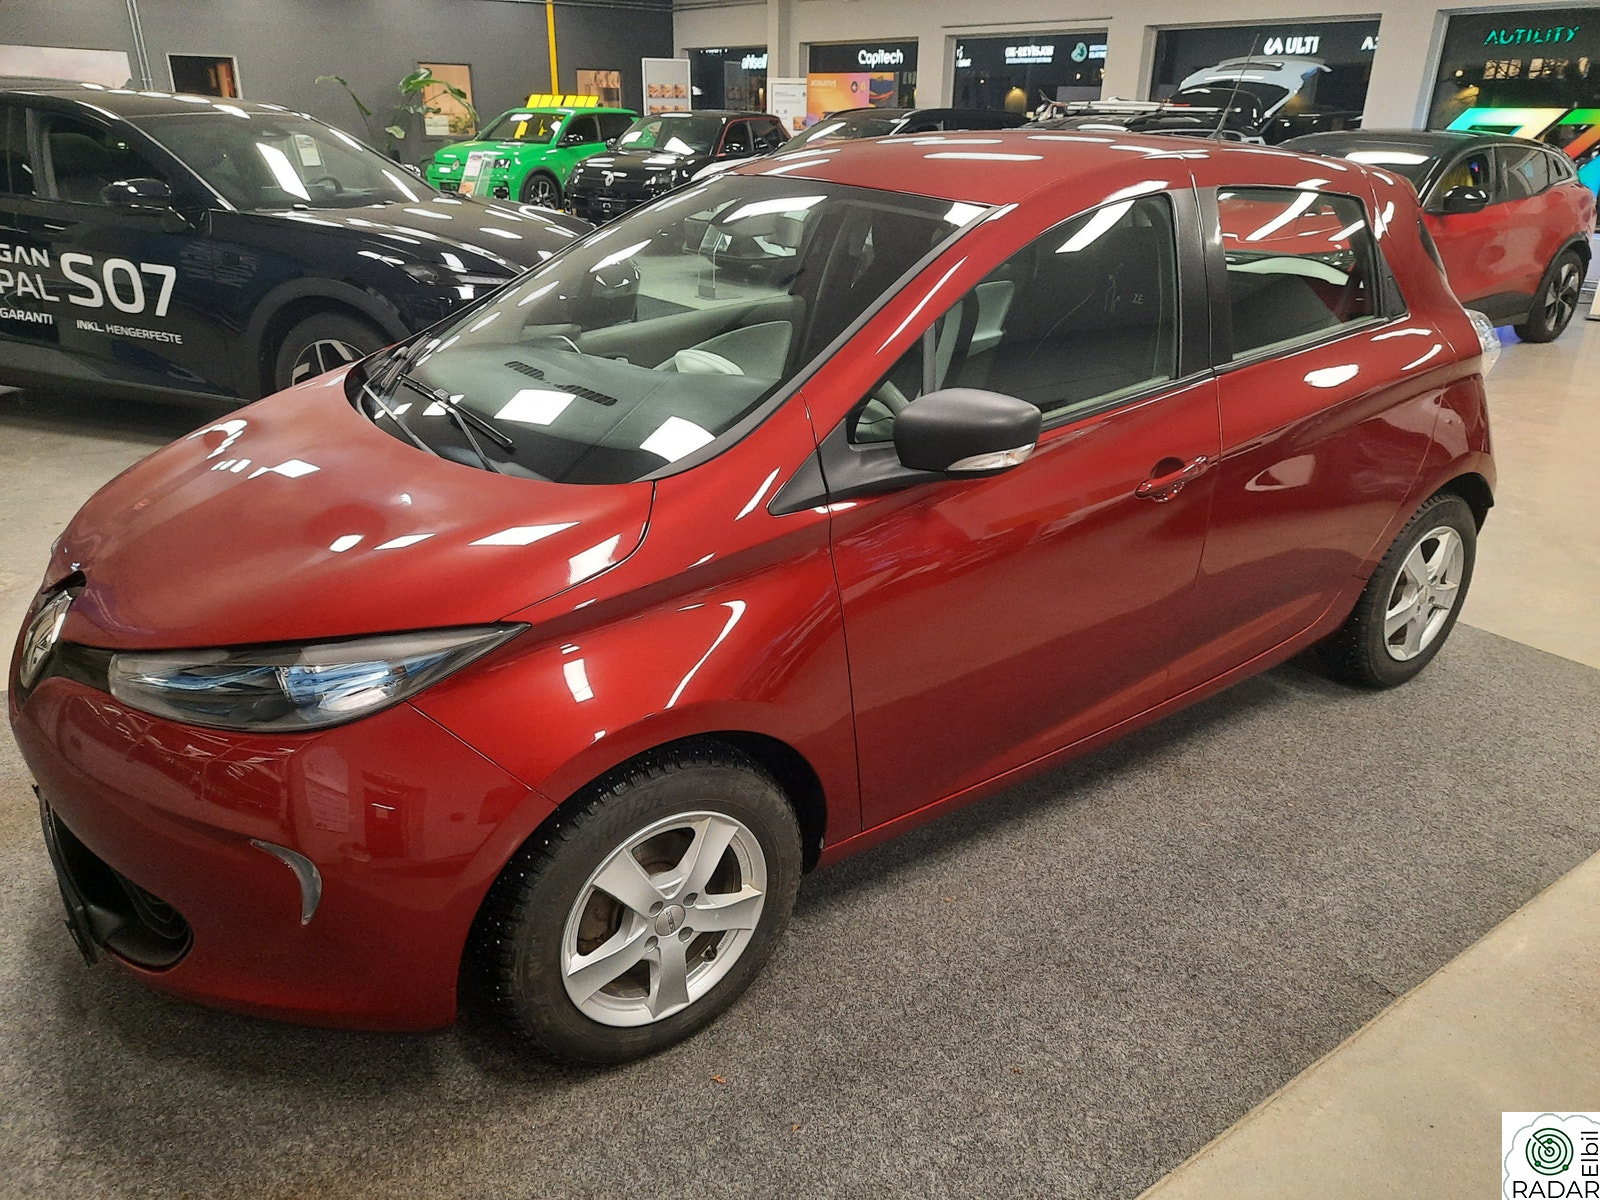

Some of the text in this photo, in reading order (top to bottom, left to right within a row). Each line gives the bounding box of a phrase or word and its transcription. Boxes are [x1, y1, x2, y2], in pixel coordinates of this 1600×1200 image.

[1483, 25, 1580, 46] AUTILITY
[0, 243, 51, 268] GAN
[60, 252, 177, 317] S07
[0, 307, 54, 325] GARANTI
[105, 323, 183, 345] HENGERFESTE
